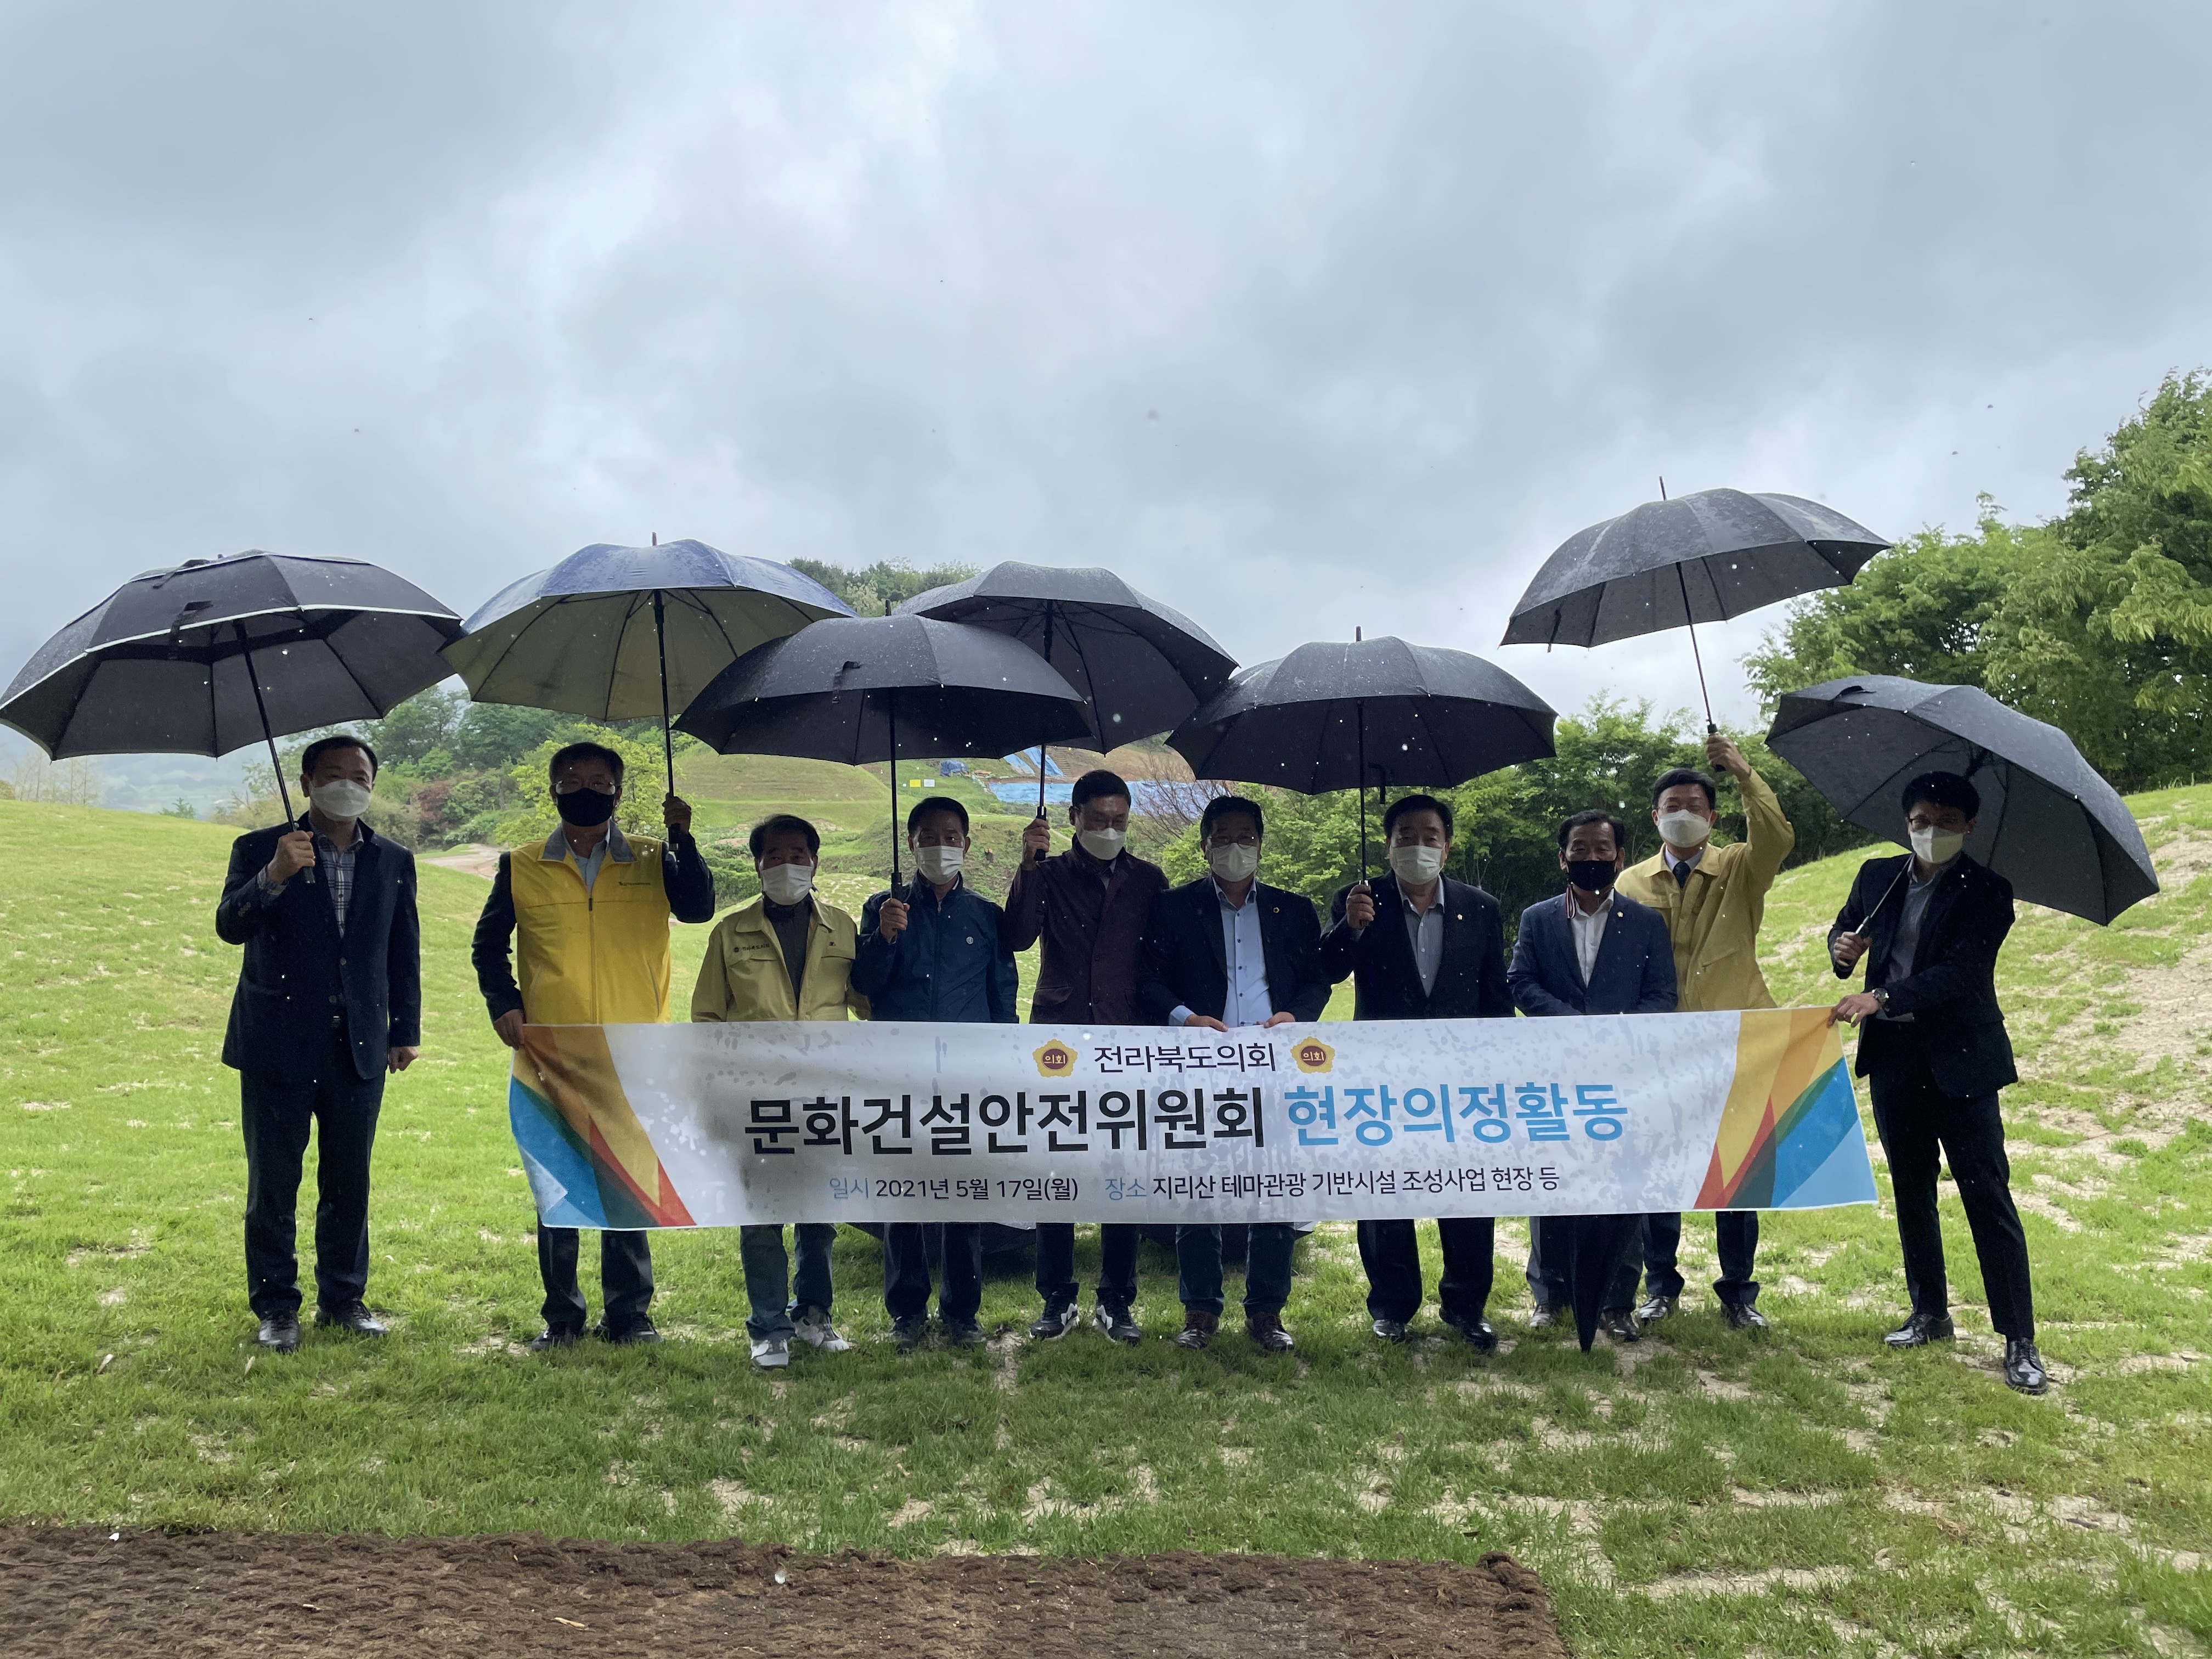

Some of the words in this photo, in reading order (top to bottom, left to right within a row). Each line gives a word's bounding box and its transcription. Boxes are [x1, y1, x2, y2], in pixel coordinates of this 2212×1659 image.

[1044, 1054, 1065, 1064] 의회
[1094, 1042, 1276, 1073] 전라북도의회
[1303, 1051, 1324, 1061] 의회
[744, 1087, 1264, 1155] 문화건설안전위원회
[1284, 1081, 1628, 1147] 현장의정활동
[829, 1177, 869, 1199] 일시
[876, 1178, 950, 1200] 2021년
[956, 1178, 989, 1200] 5월
[996, 1177, 1078, 1201] 17일(월)
[1104, 1177, 1147, 1201] 장소
[1153, 1175, 1216, 1200] 지리산
[1221, 1172, 1307, 1199] 테마관광
[1312, 1170, 1396, 1196] 기반시설
[1402, 1167, 1486, 1193] 조성사업
[1491, 1166, 1534, 1191] 현장
[1538, 1167, 1560, 1191] 등
